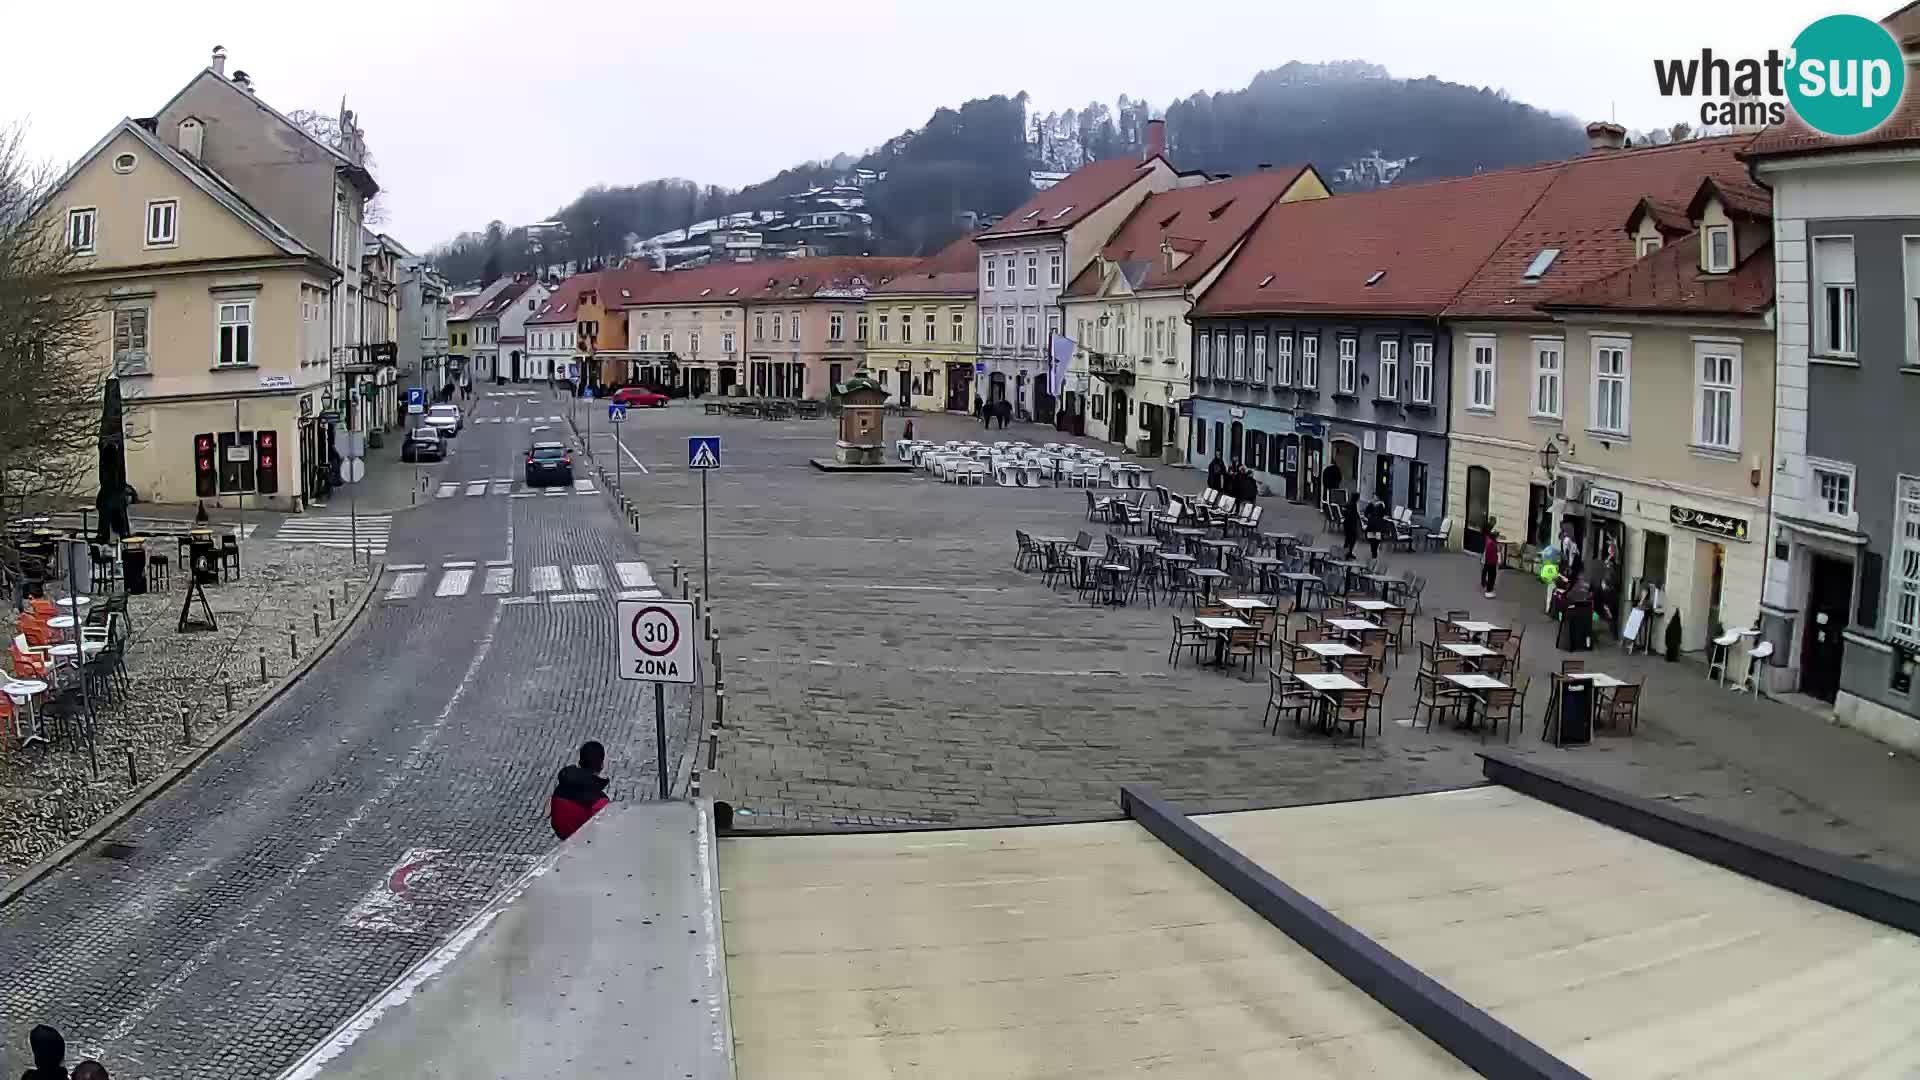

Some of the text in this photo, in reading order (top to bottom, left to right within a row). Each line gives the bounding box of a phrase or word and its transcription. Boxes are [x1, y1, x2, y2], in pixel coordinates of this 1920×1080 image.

[411, 391, 420, 402] P
[644, 622, 667, 643] 30
[634, 659, 678, 676] ZONA
